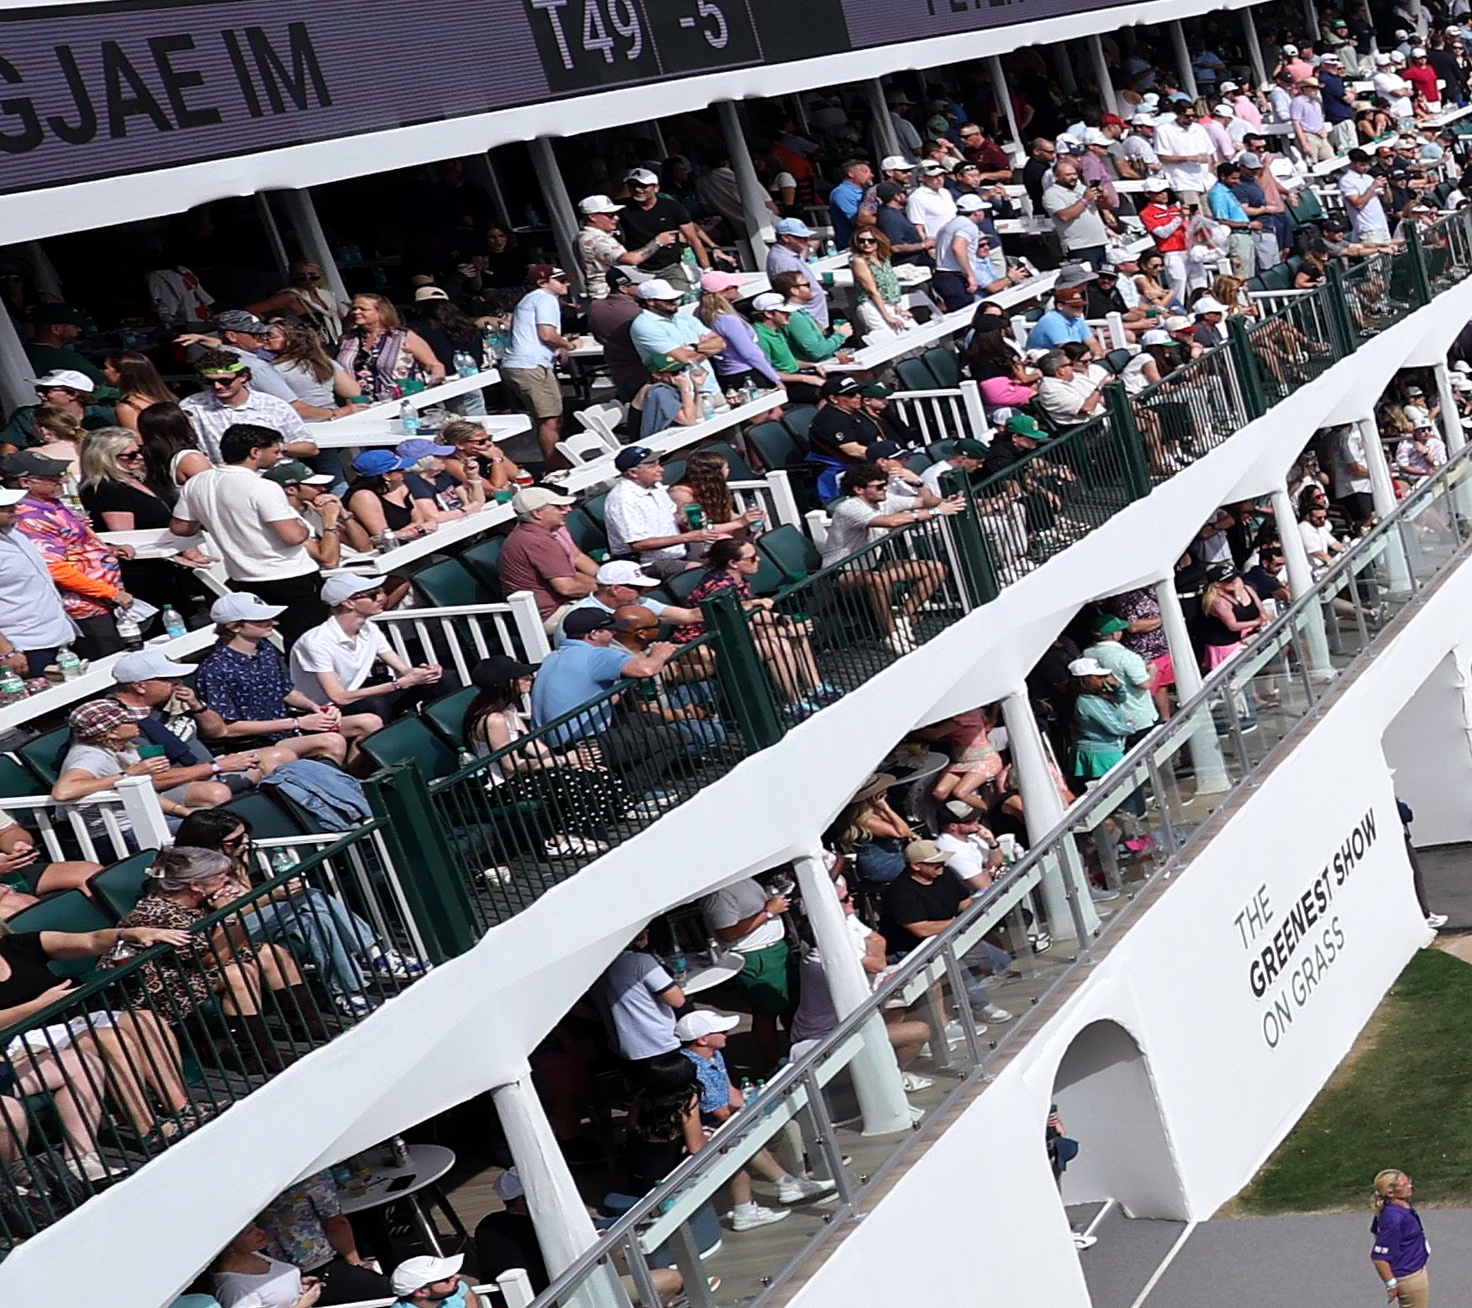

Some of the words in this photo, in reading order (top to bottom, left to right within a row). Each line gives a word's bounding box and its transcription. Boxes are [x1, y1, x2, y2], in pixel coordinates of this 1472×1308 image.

[220, 22, 334, 119] IM
[1234, 884, 1274, 950] THE
[1249, 865, 1334, 998] GREENEST
[1333, 807, 1377, 886] SHOW
[1263, 990, 1293, 1048] ON
[1291, 916, 1345, 1007] GRASS
